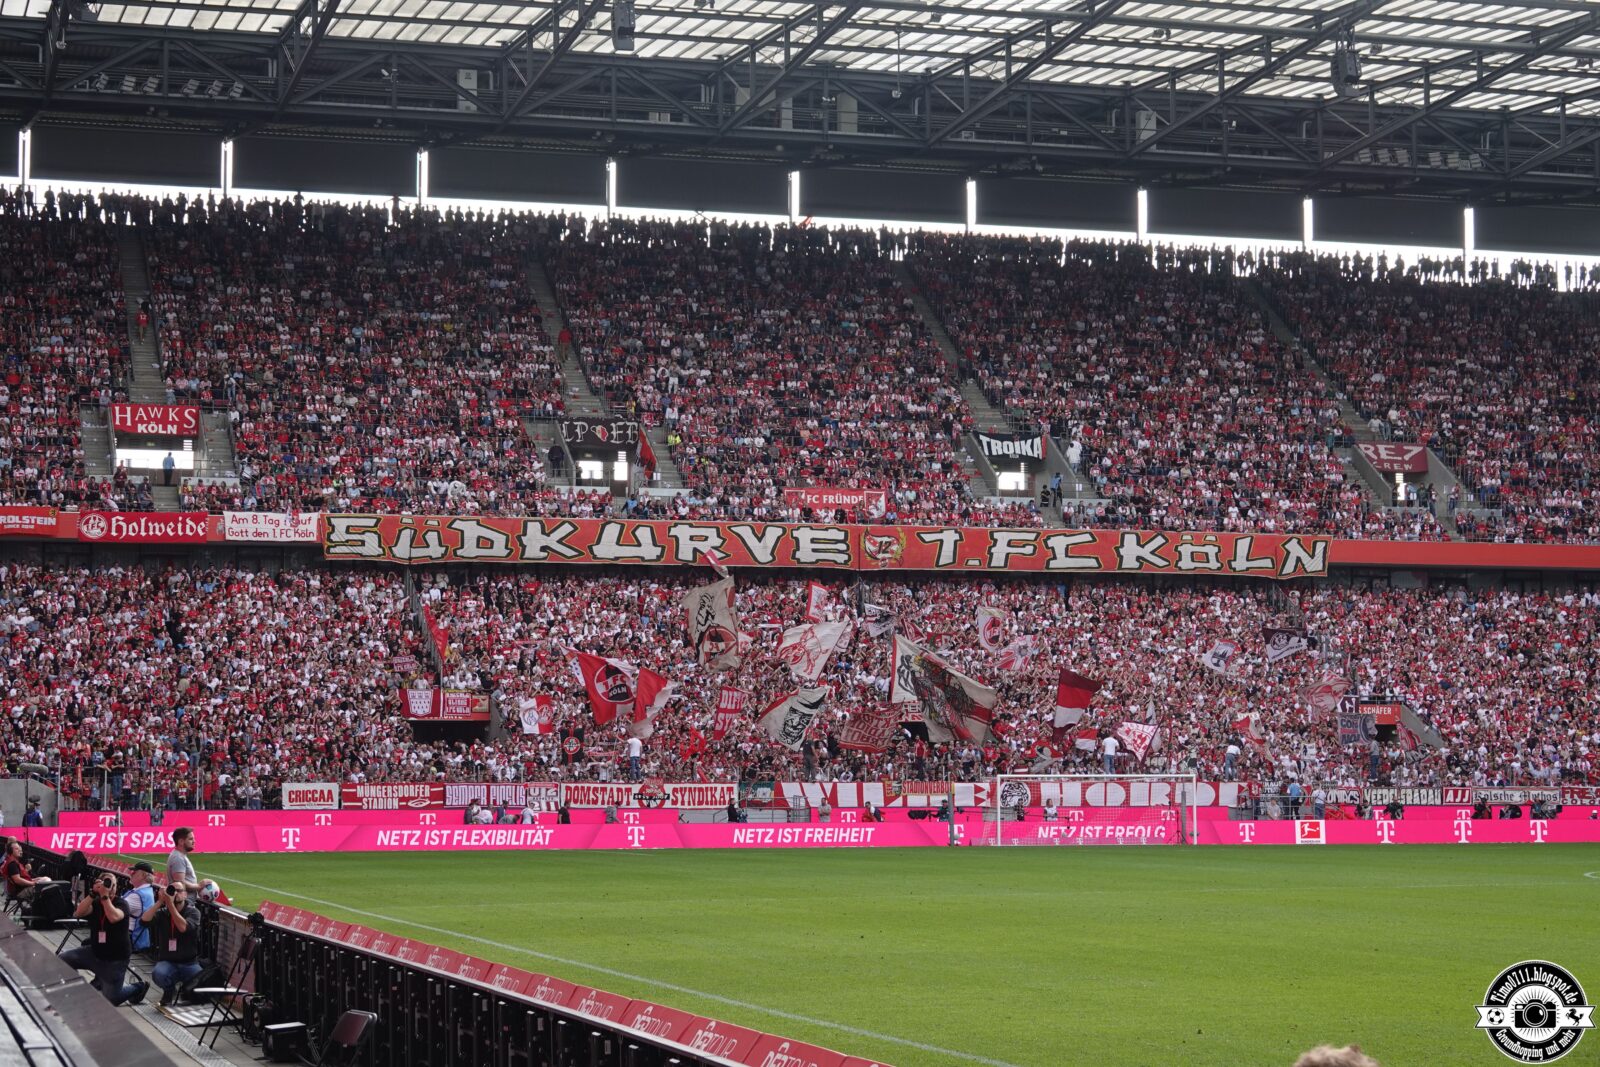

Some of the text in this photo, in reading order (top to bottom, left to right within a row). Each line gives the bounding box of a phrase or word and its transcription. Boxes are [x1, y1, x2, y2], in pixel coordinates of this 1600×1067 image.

[115, 406, 197, 429] HAWKS
[137, 423, 178, 435] KÖLN
[979, 434, 1042, 460] TROIKA
[807, 494, 820, 504] FC
[111, 515, 207, 540] Holweide
[231, 514, 249, 525] Am
[251, 514, 261, 525] 8.
[263, 514, 280, 527] Tag
[228, 527, 249, 538] Gott
[252, 527, 270, 538] den
[279, 528, 292, 539] FC
[293, 528, 315, 539] Köln
[325, 515, 853, 566] SÜDKURVE
[1115, 532, 1329, 577] KÖLN
[1363, 705, 1392, 715] SCHÄFER
[288, 789, 334, 804] CRICCAA
[357, 783, 431, 797] MÜNGERSDORFER
[445, 785, 526, 806] SEMPER FIDELIS
[564, 786, 735, 807] DOMSTADT SYNDIKAT
[1446, 790, 1470, 803] AJJ
[362, 798, 399, 809] STADION
[50, 832, 96, 849] NETZ
[99, 832, 128, 849] IST
[376, 826, 554, 846] NETZ IST FLEXIBILITÄT
[733, 827, 875, 844] NETZ IST FREIHEIT
[1079, 826, 1105, 838] IST
[687, 1029, 738, 1059] DERTOUR
